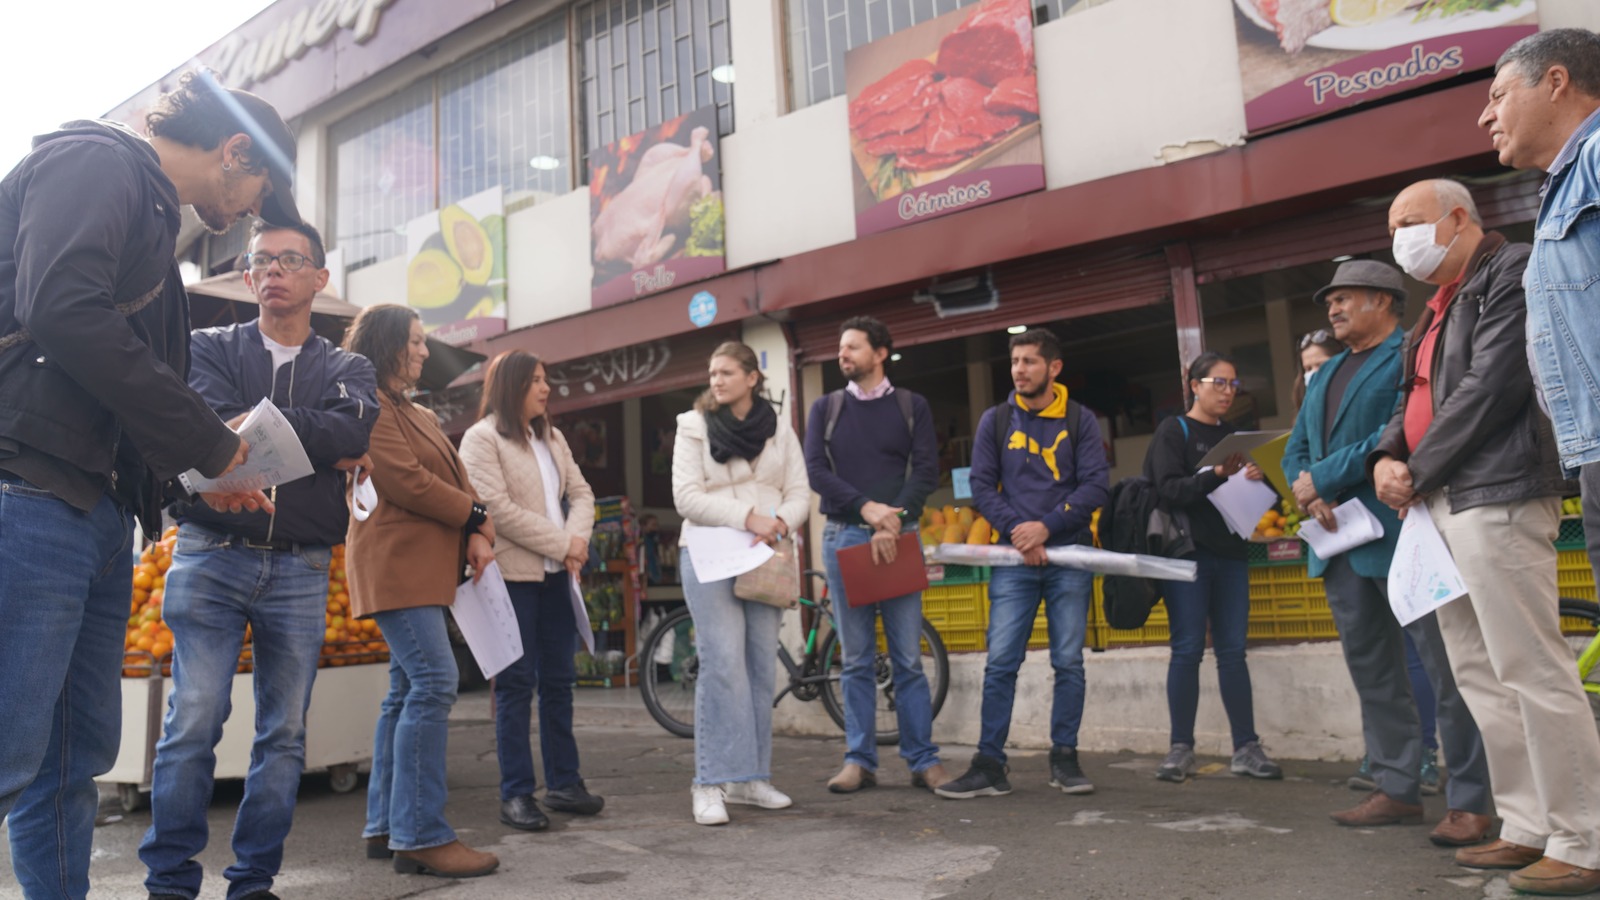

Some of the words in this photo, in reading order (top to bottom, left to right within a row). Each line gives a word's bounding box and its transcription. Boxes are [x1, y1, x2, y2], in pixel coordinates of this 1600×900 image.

[1304, 44, 1463, 104] Pescados
[898, 180, 991, 220] Cárnicos
[631, 263, 676, 295] Pollo
